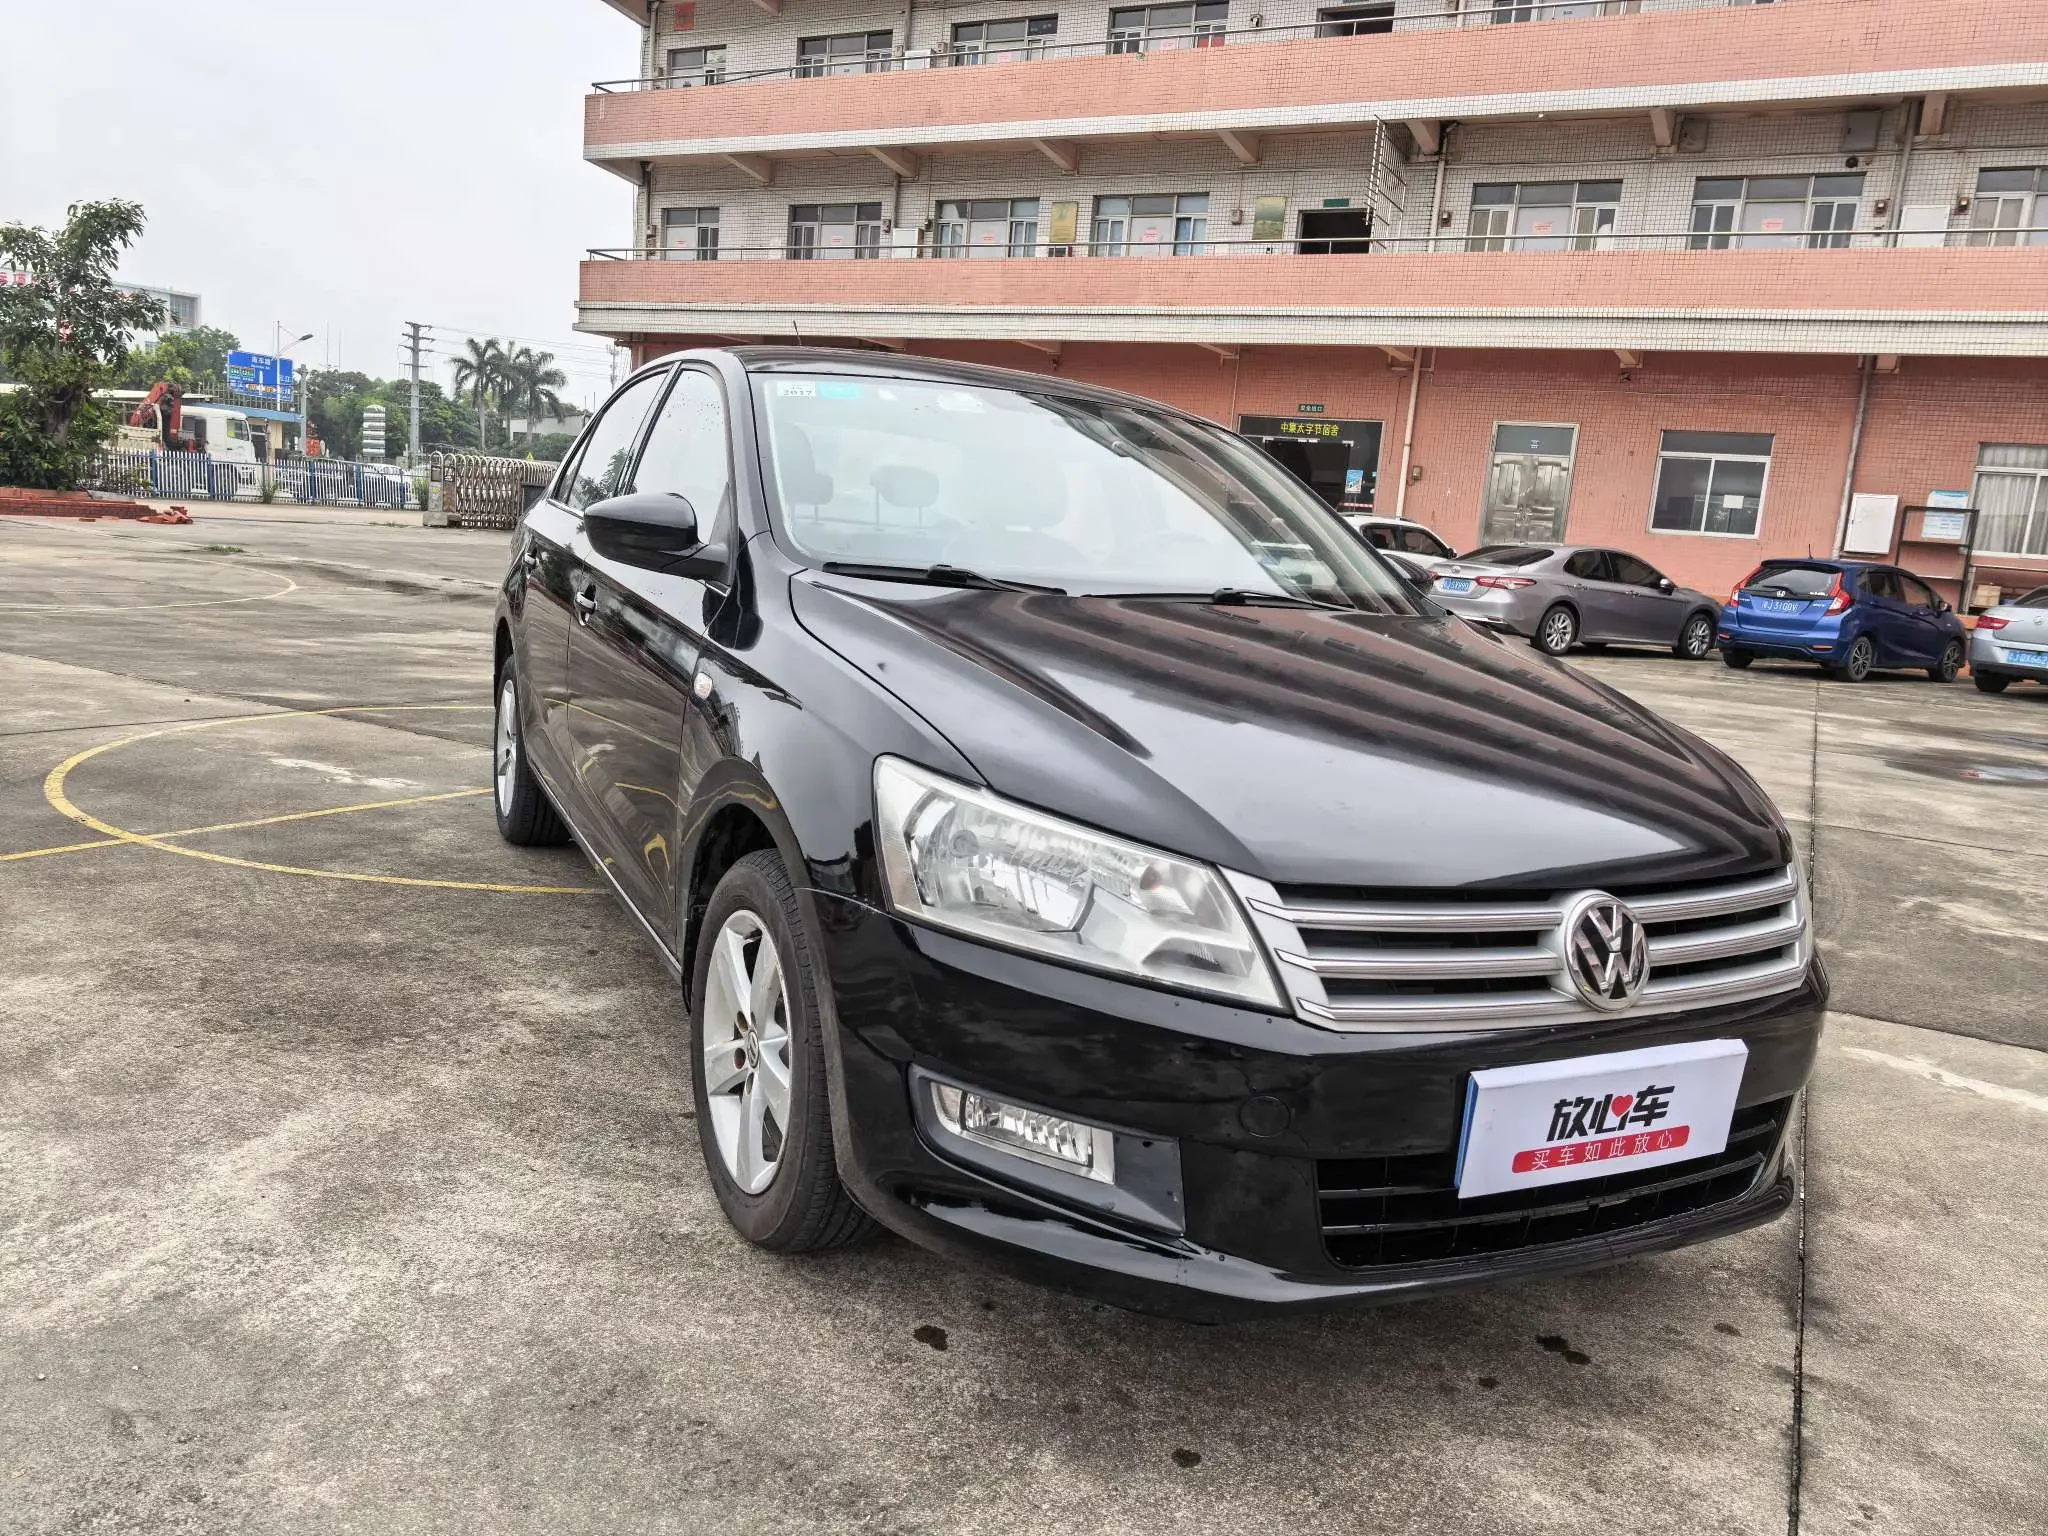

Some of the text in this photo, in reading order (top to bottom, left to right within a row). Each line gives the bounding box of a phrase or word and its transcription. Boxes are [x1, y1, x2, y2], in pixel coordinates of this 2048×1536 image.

[1546, 1085, 1675, 1142] 放心车
[1531, 1130, 1673, 1171] 买车如此放心
